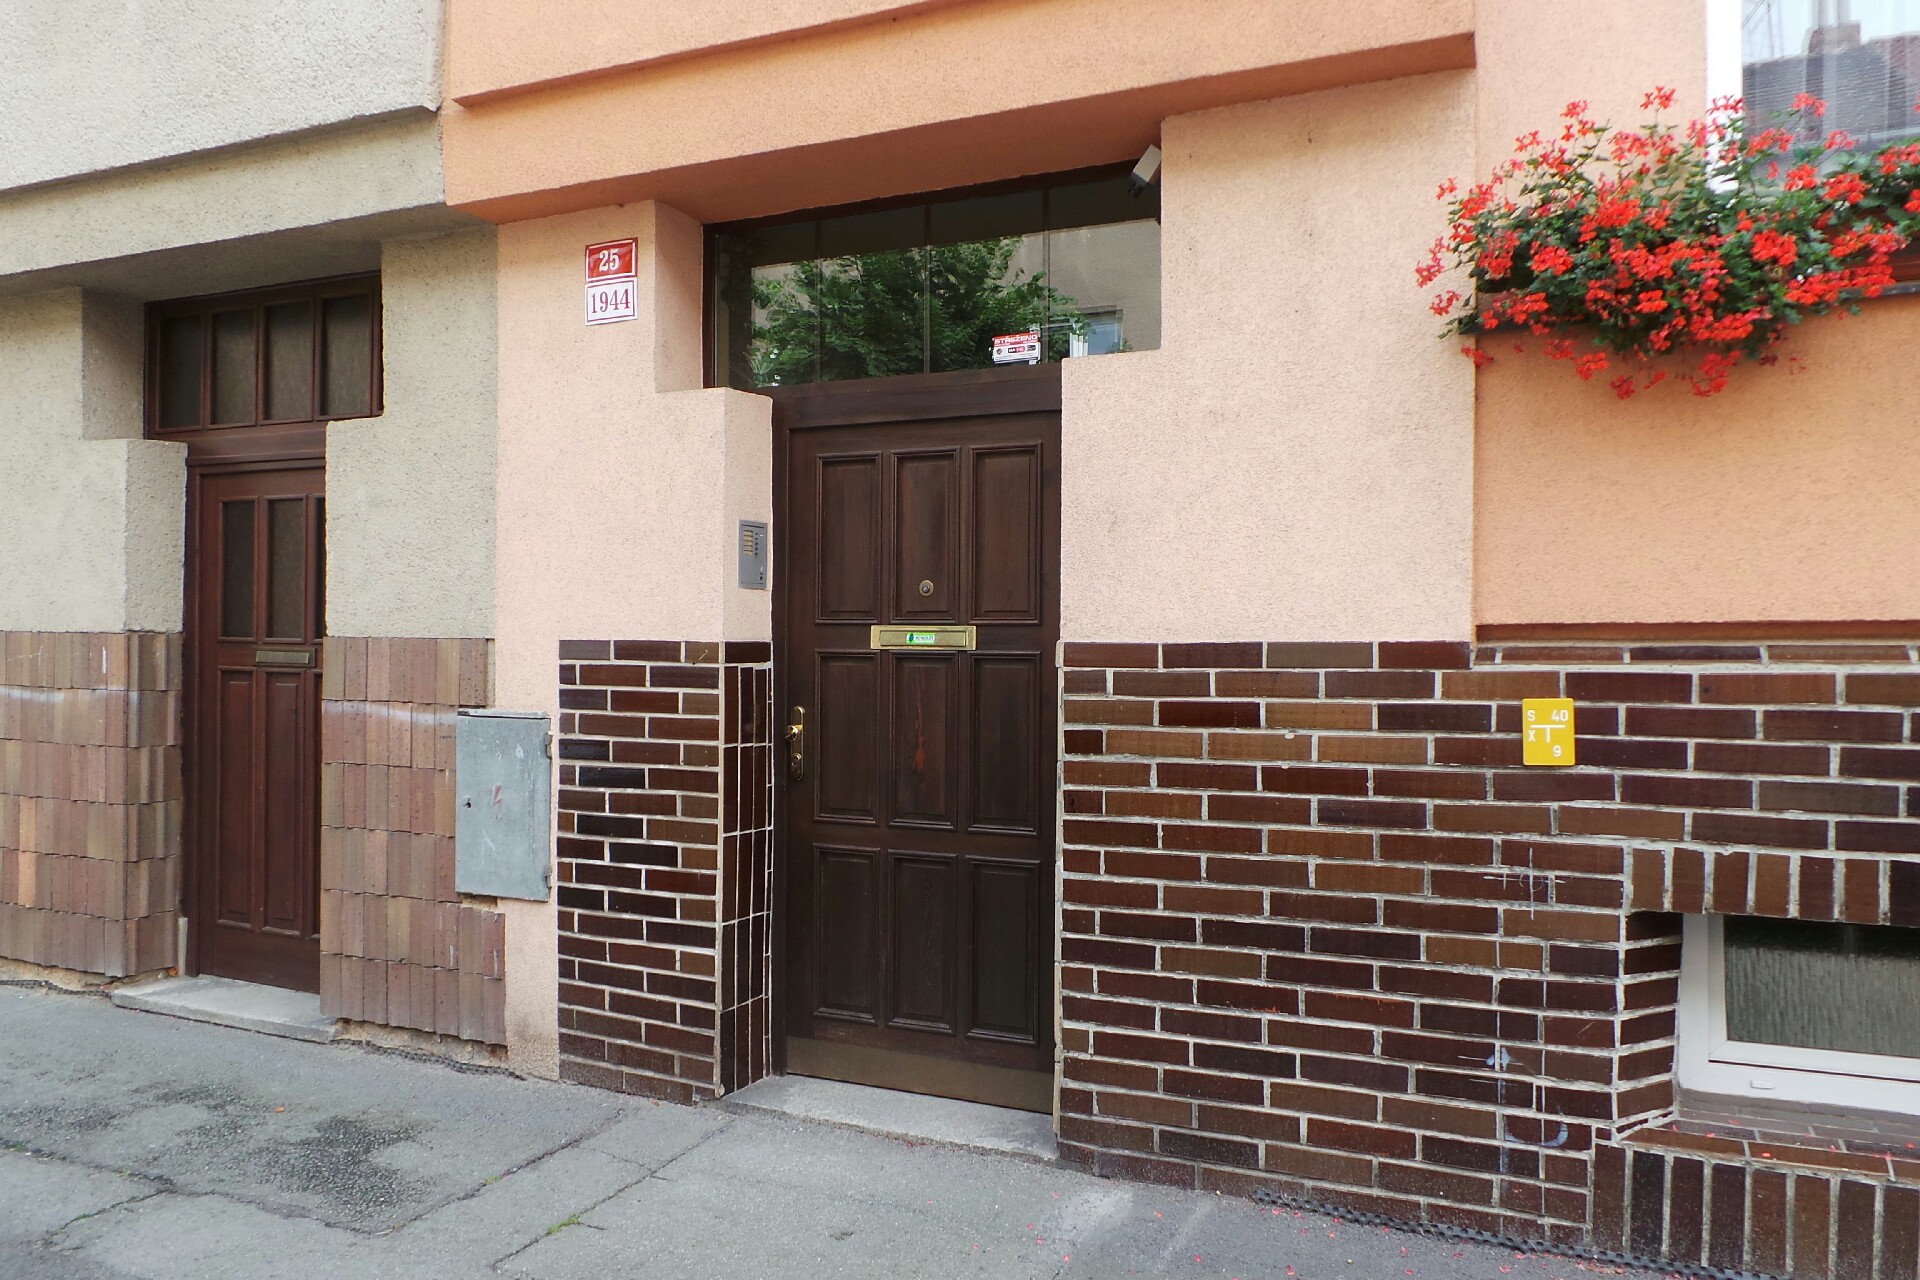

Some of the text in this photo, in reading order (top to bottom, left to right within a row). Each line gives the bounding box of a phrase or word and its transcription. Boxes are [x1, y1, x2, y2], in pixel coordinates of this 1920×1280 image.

[598, 248, 620, 272] 25
[591, 288, 631, 314] 1944
[994, 334, 1038, 344] STŘEŽENO
[1527, 709, 1569, 722] S 40
[1528, 729, 1536, 742] X
[1553, 744, 1562, 757] 9
